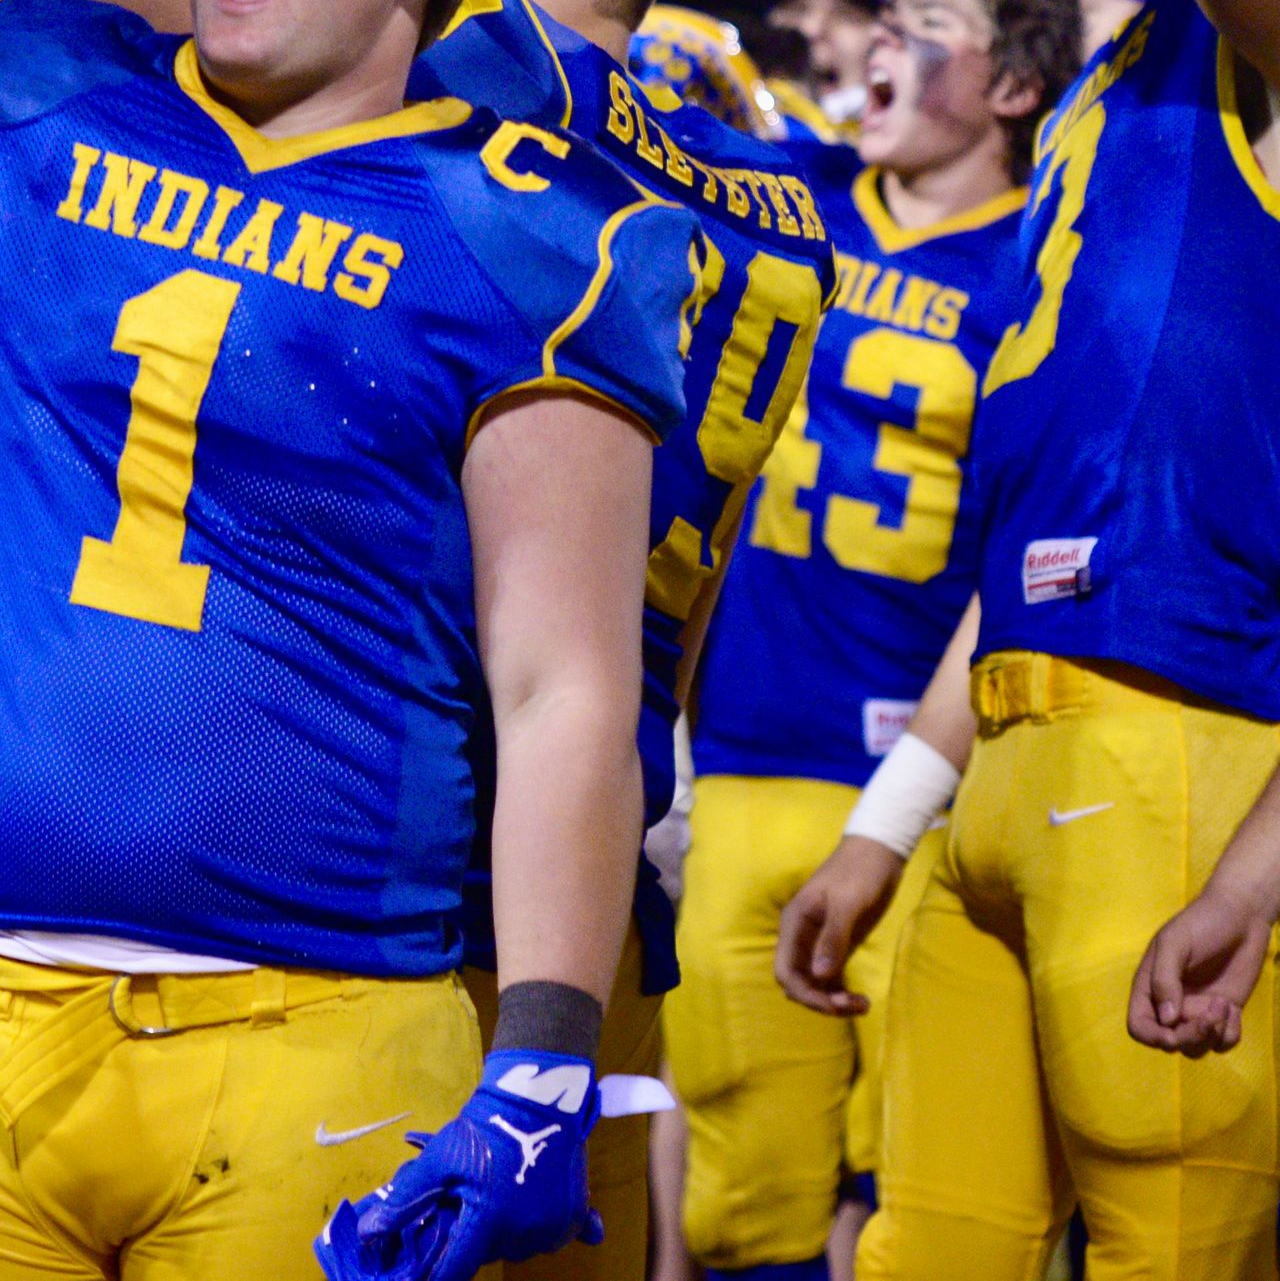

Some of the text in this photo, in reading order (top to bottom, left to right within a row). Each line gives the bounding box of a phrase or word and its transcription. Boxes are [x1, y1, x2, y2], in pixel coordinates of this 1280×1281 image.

[480, 120, 570, 192] C
[56, 142, 404, 310] INDIANS
[70, 269, 242, 633] 1
[1028, 548, 1081, 569] Riddell
